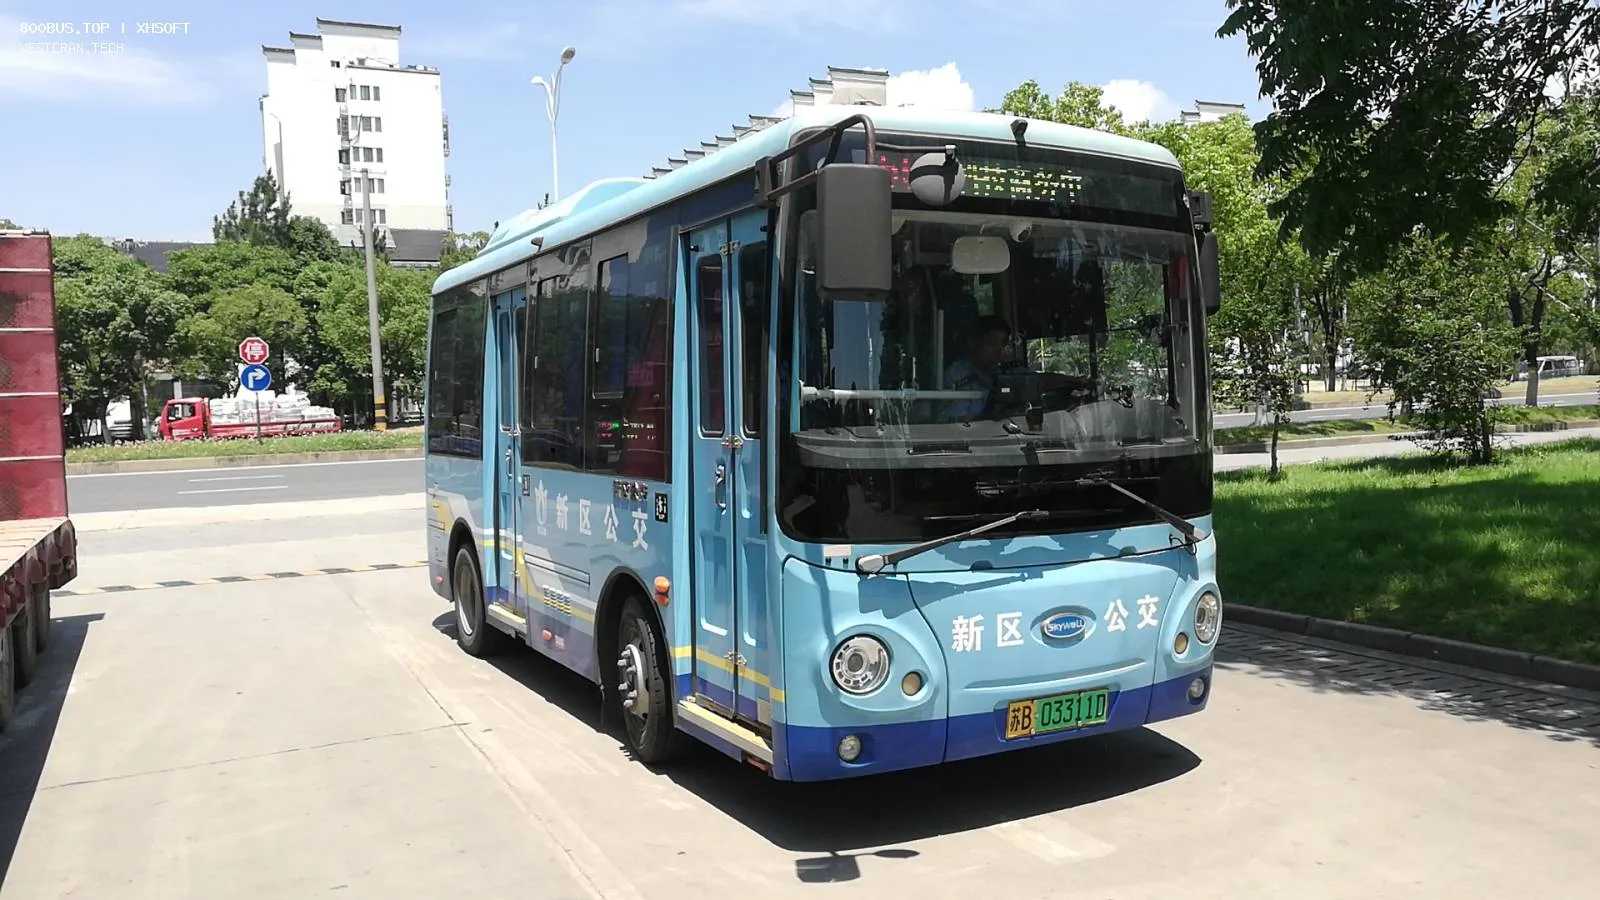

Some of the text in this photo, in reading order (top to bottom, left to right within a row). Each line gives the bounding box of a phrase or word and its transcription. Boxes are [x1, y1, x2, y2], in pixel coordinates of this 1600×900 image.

[244, 342, 264, 360] 停
[556, 493, 648, 551] 新区公交
[951, 594, 1160, 653] 新区 公交
[1010, 694, 1105, 732] 苏B 03311D
